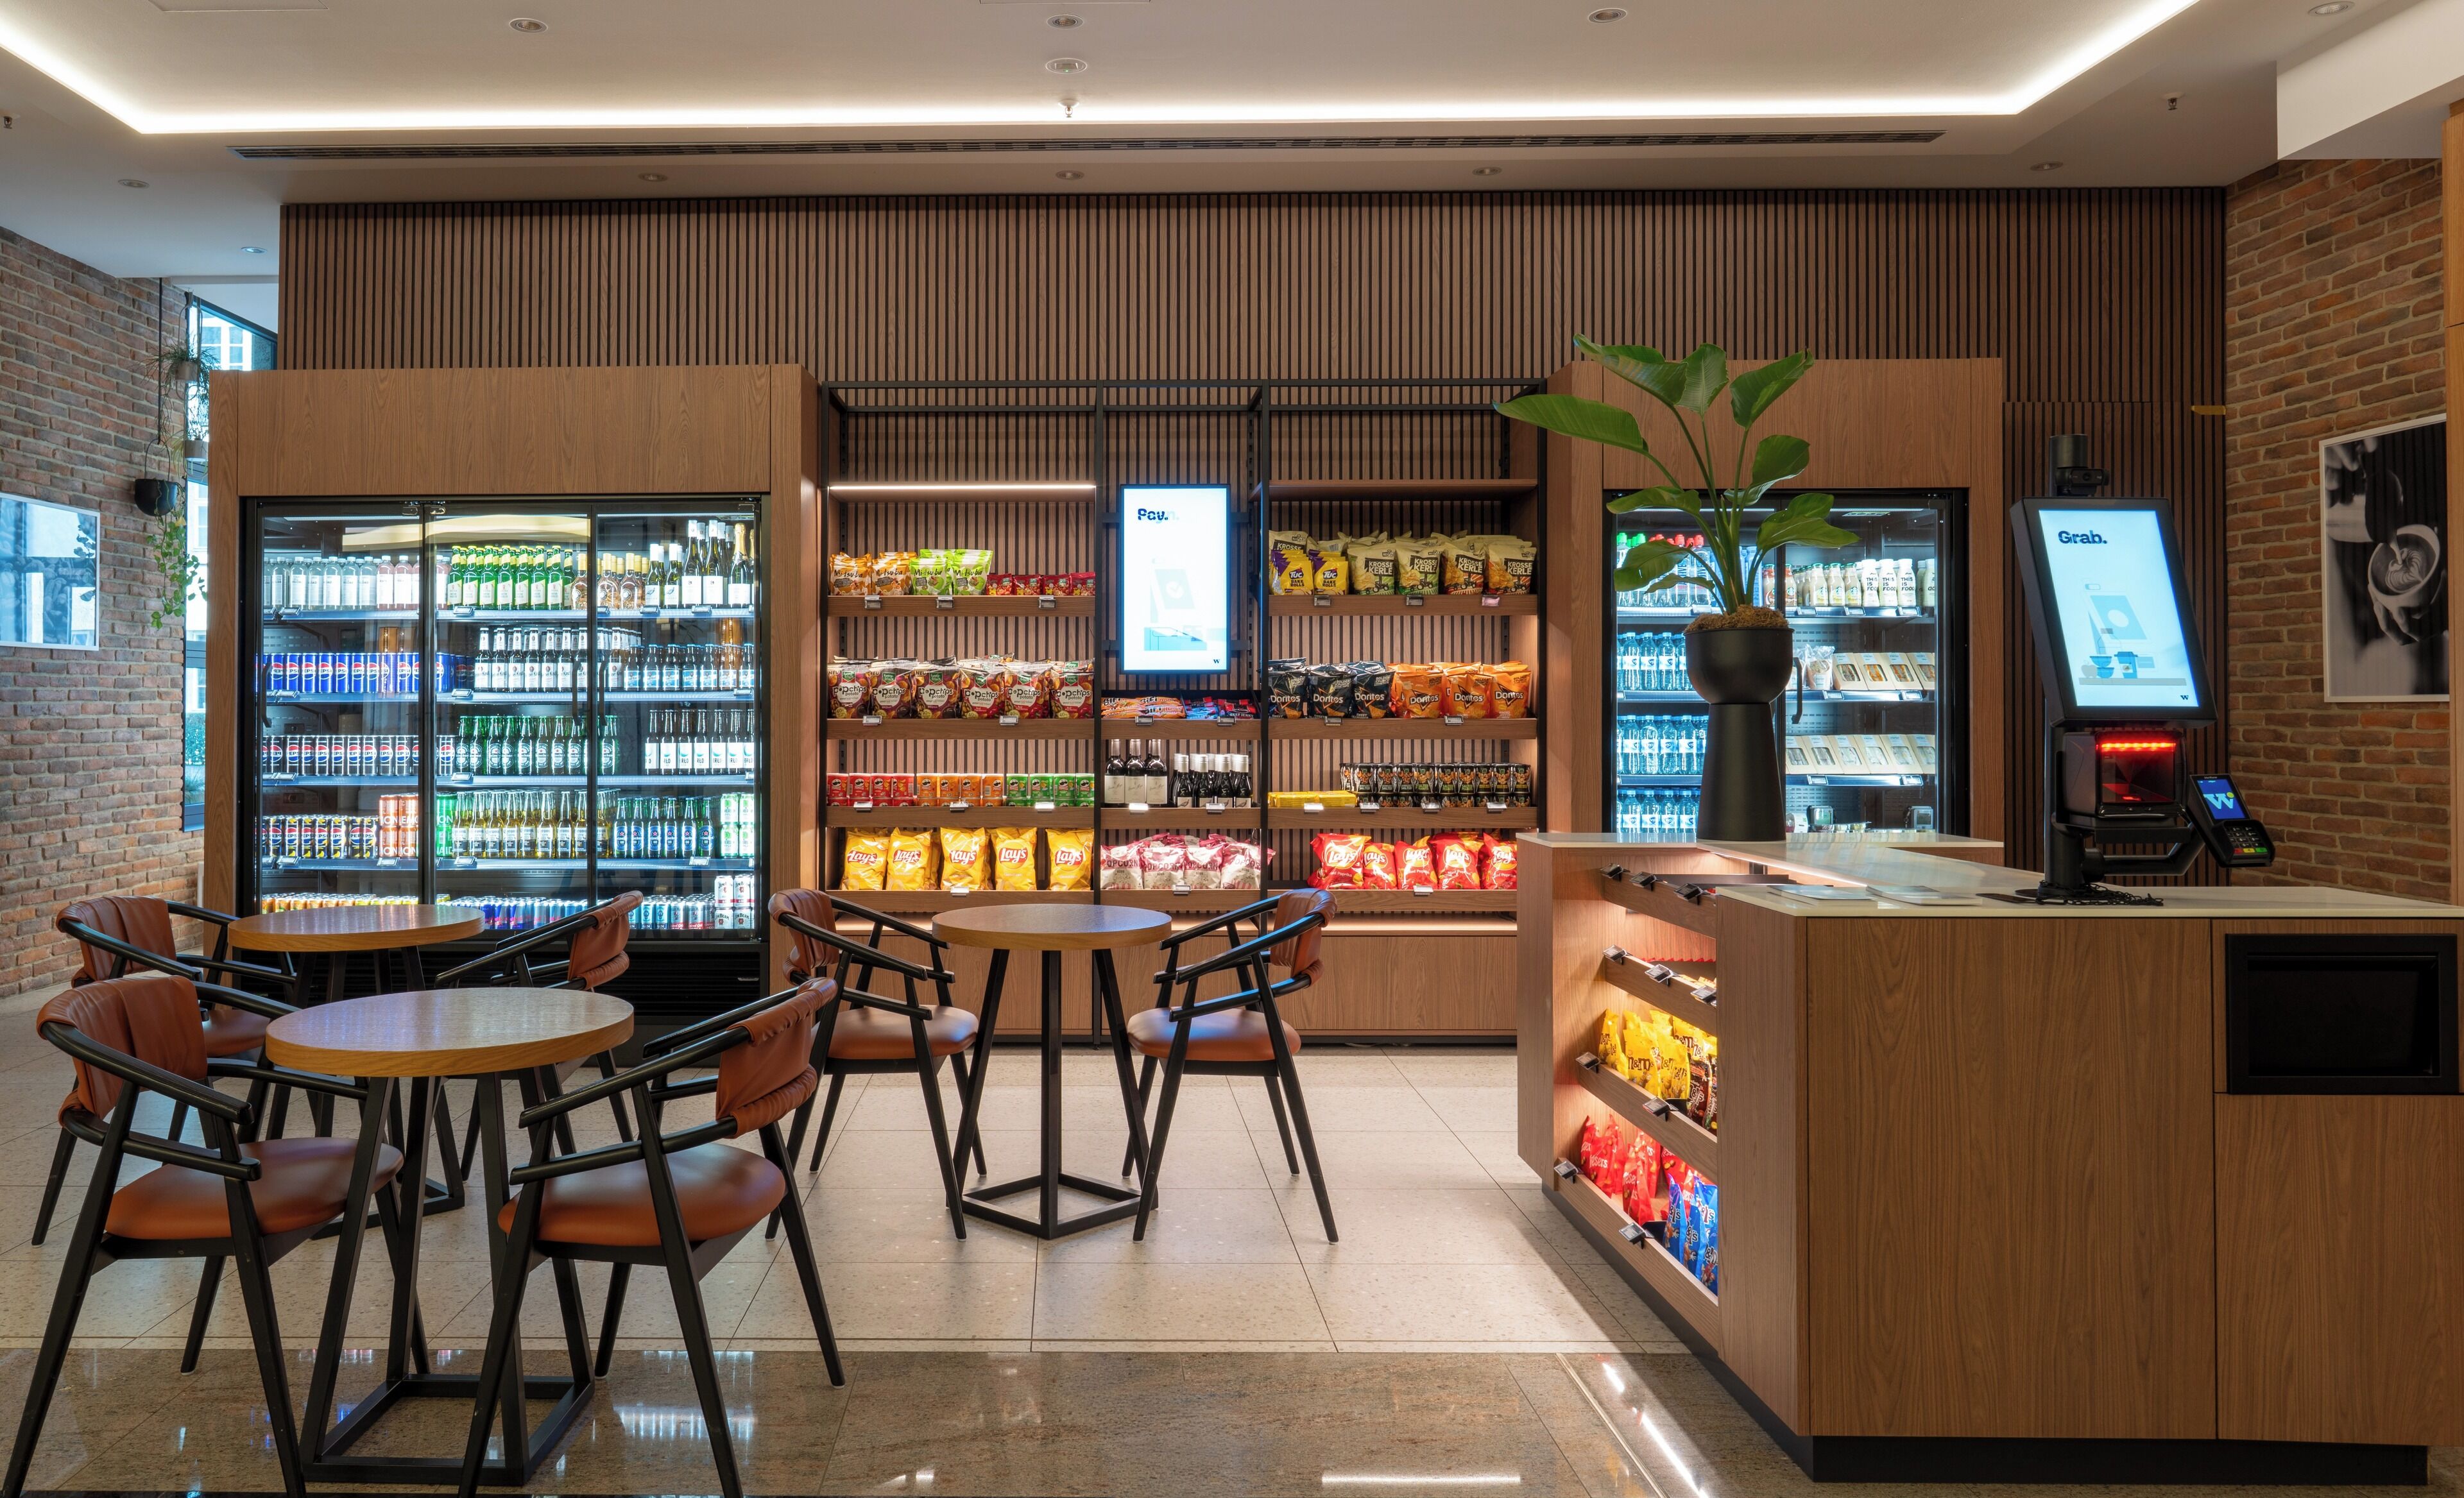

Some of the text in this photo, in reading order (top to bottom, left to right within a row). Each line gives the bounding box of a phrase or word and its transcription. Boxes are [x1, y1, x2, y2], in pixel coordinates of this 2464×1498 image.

[2058, 530, 2107, 544] Grab.
[1459, 557, 1483, 566] KROSSE
[1414, 564, 1436, 572] KERLE
[1458, 563, 1482, 573] KERLE
[1270, 695, 1300, 703] Doritos
[1313, 694, 1343, 704] Doritos
[1355, 693, 1385, 701] Doritos
[1410, 695, 1439, 704] Doritos
[1454, 692, 1484, 702] Doritos
[1495, 691, 1524, 699] Doritos
[1000, 847, 1027, 864] Lay's
